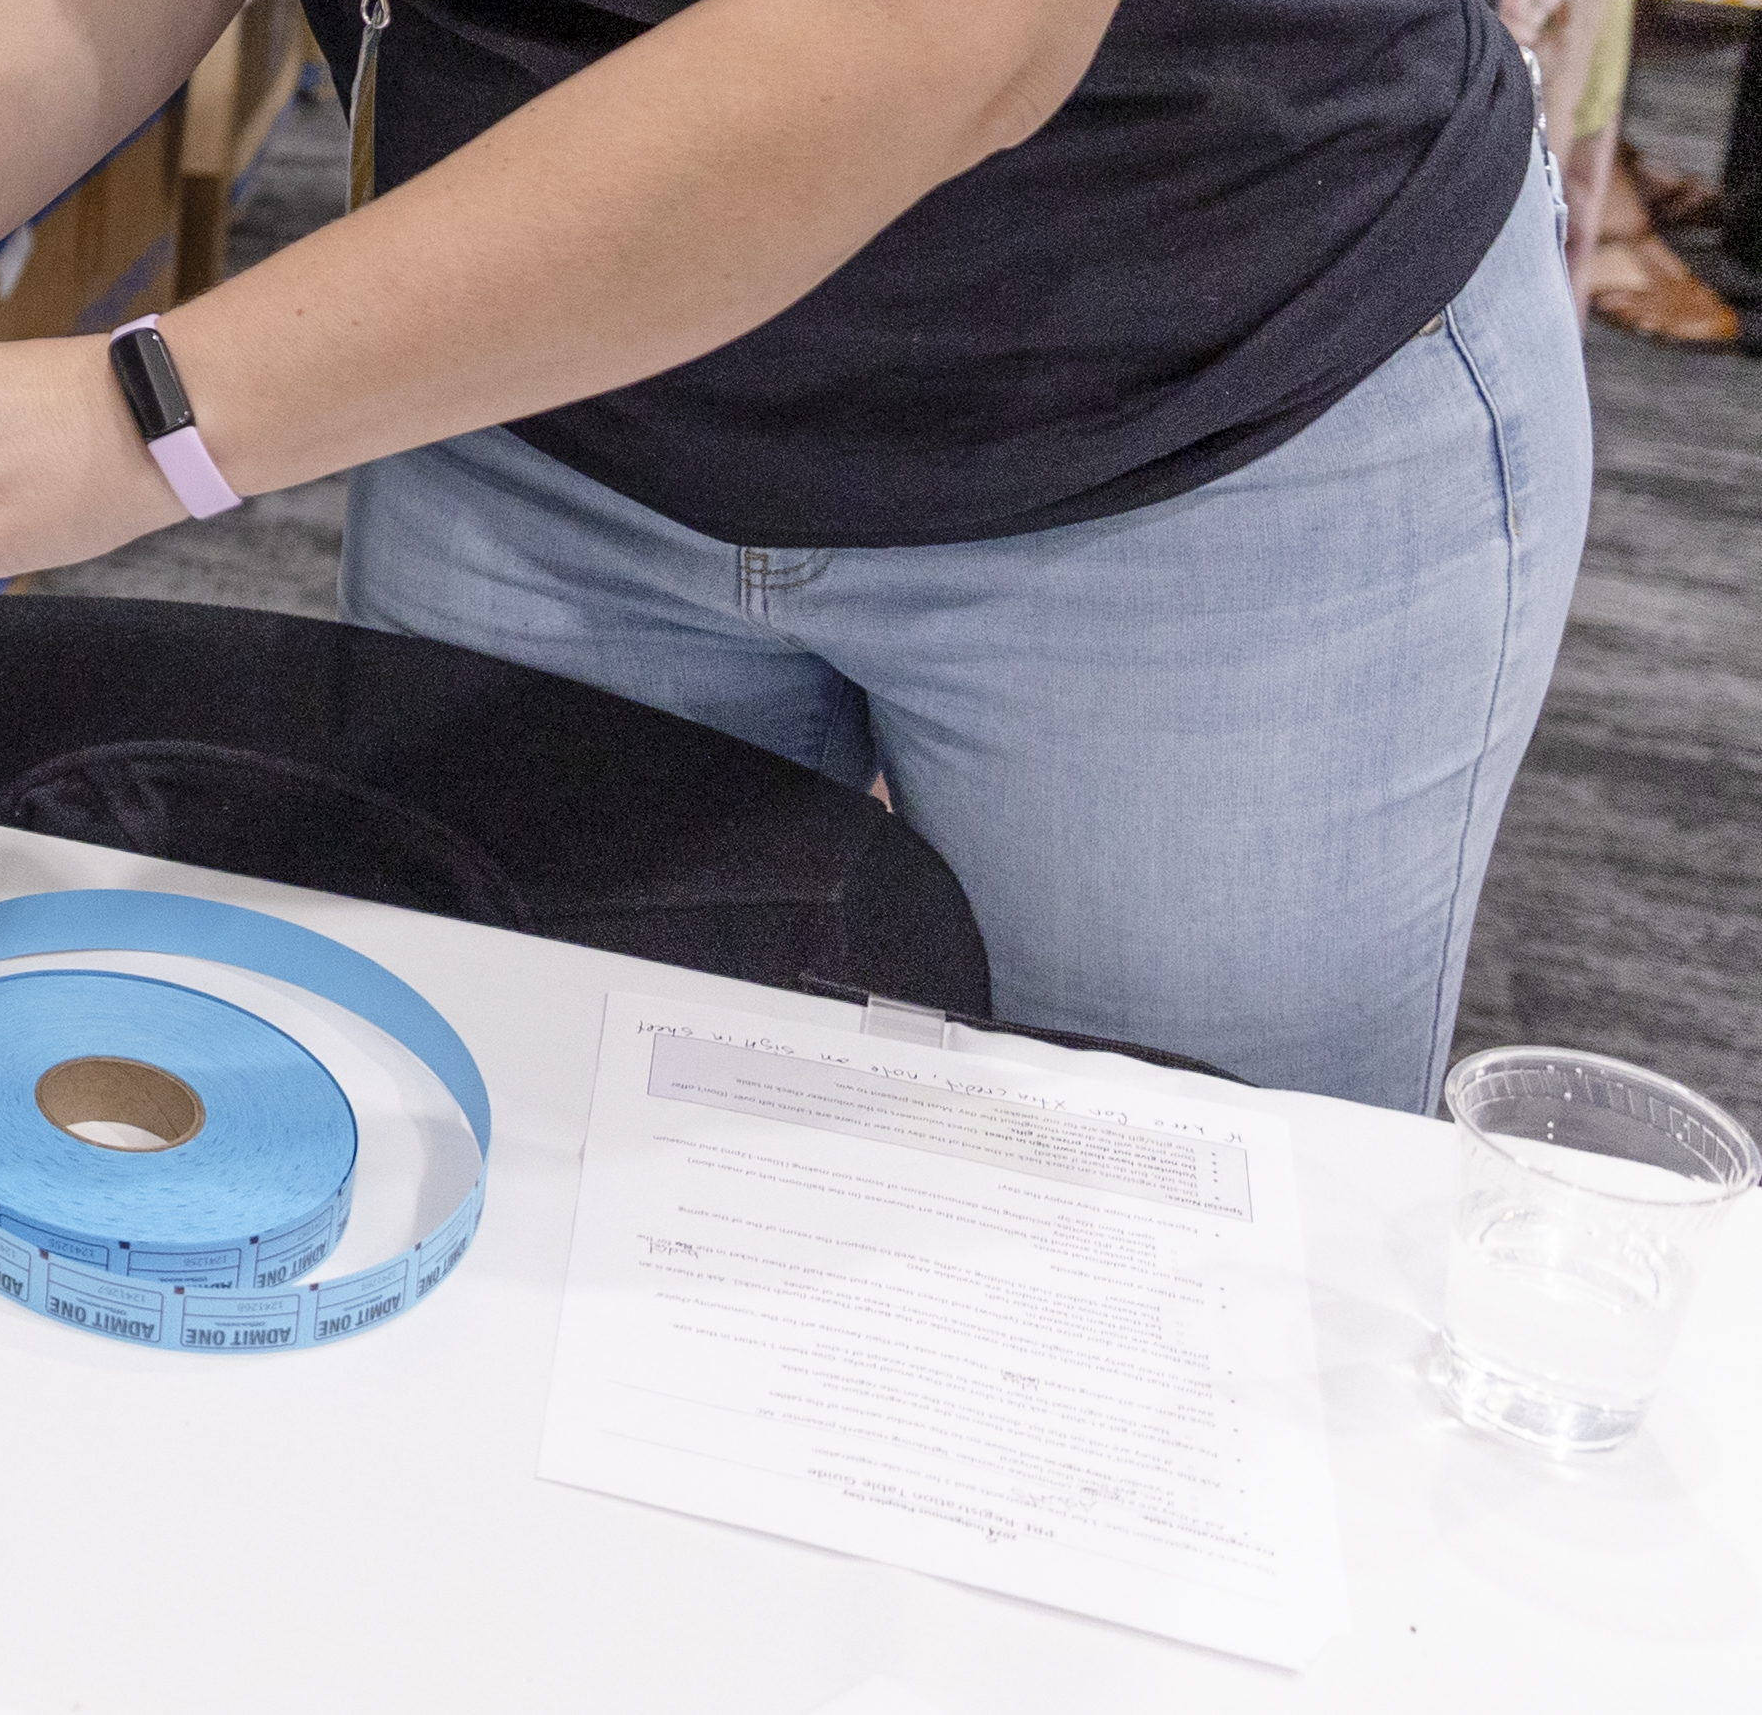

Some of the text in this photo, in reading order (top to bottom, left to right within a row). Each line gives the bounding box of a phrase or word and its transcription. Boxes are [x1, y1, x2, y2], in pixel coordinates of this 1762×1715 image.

[257, 1266, 287, 1287] ONE
[49, 1296, 155, 1340] ADMIT ONE
[318, 1291, 401, 1337] ADMIT ONE
[185, 1326, 292, 1346] ADMIT ONE
[805, 1464, 856, 1487] Guide
[860, 1477, 907, 1500] Table
